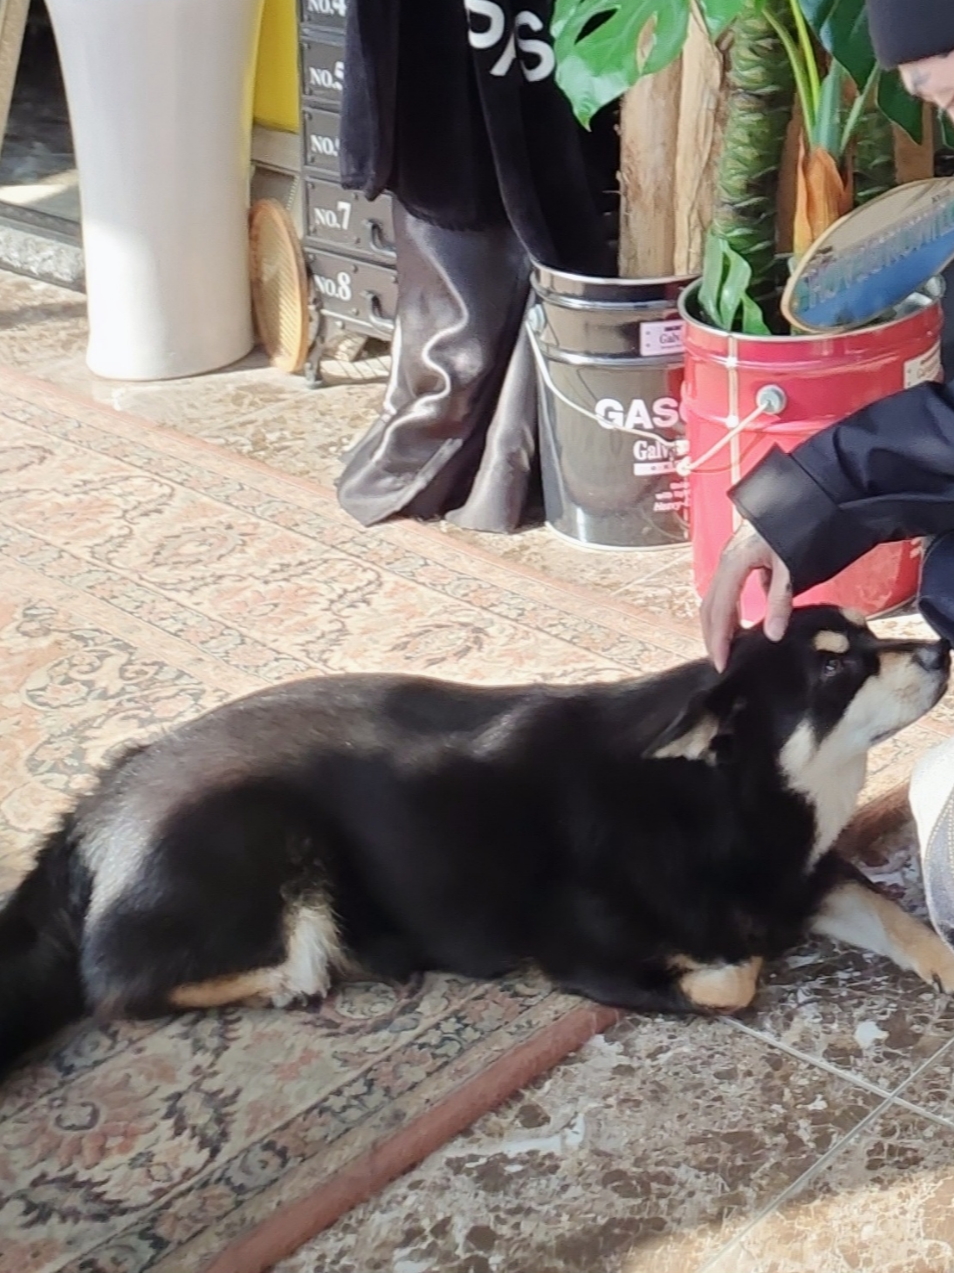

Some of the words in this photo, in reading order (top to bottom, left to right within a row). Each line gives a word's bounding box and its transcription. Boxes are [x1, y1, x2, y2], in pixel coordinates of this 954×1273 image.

[310, 133, 341, 157] NO.
[313, 201, 352, 231] NO.7
[314, 271, 352, 302] NO.8
[595, 397, 688, 430] GAS
